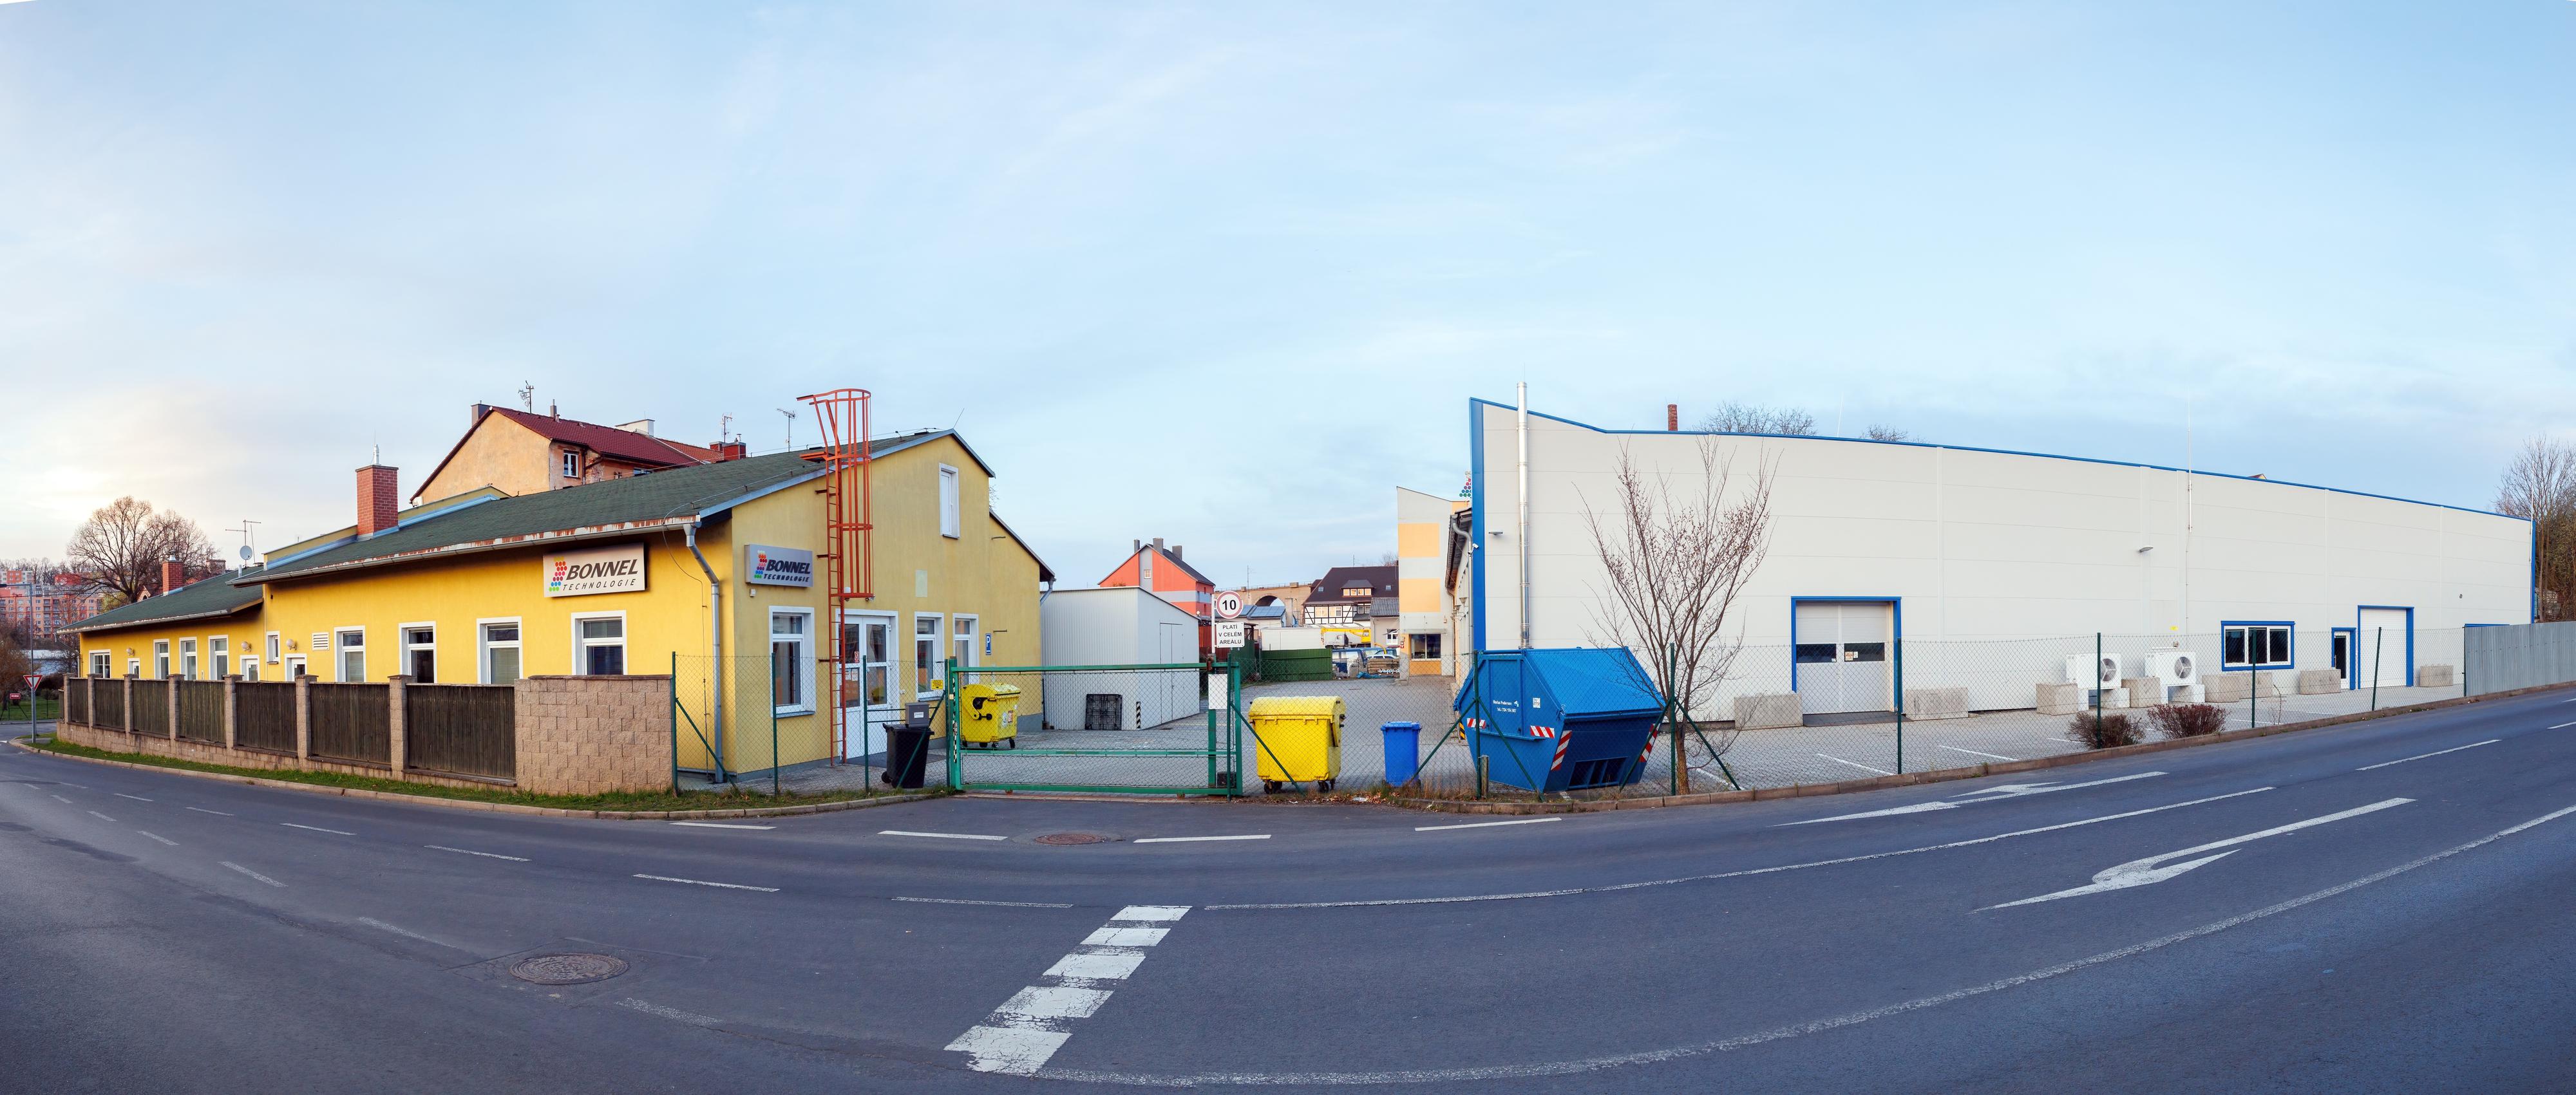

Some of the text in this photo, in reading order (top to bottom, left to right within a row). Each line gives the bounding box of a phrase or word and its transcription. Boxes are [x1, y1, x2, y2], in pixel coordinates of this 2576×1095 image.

[566, 559, 638, 580] BONNEL
[766, 559, 810, 574] BONNEL
[563, 579, 636, 590] TECHNOLOGIE
[1222, 600, 1236, 610] 10
